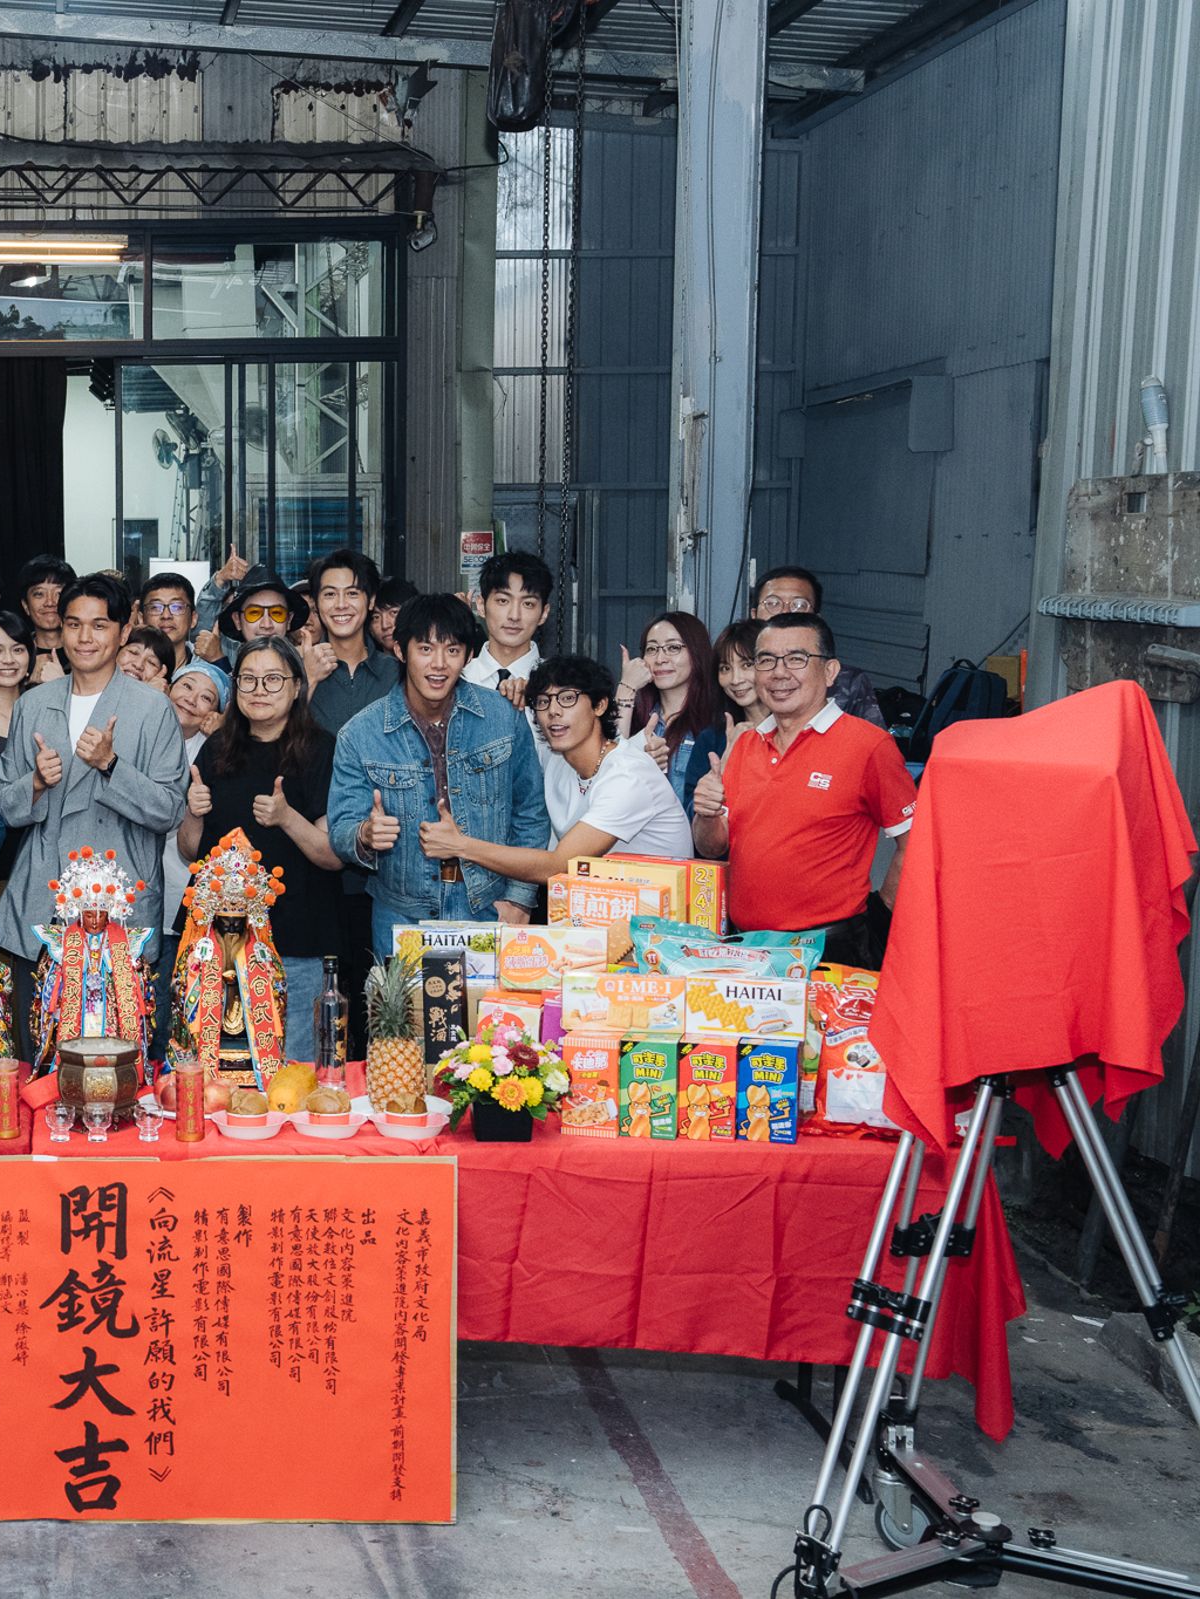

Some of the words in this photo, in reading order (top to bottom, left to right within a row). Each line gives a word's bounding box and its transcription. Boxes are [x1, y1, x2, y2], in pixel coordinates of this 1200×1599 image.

[422, 934, 471, 946] HAITAI
[726, 985, 781, 1000] HAITAI
[635, 1067, 662, 1079] MINI
[694, 1070, 721, 1081] MINI
[754, 1071, 782, 1082] MINI
[233, 1204, 252, 1248] 製作
[360, 1208, 377, 1246] 出品
[340, 1207, 357, 1323] 文化內容策進院
[412, 1208, 432, 1342] 嘉義市政府文化局
[322, 1207, 341, 1396] 聯合數位文創股份有限公司
[40, 1181, 141, 1513] 開鏡大吉
